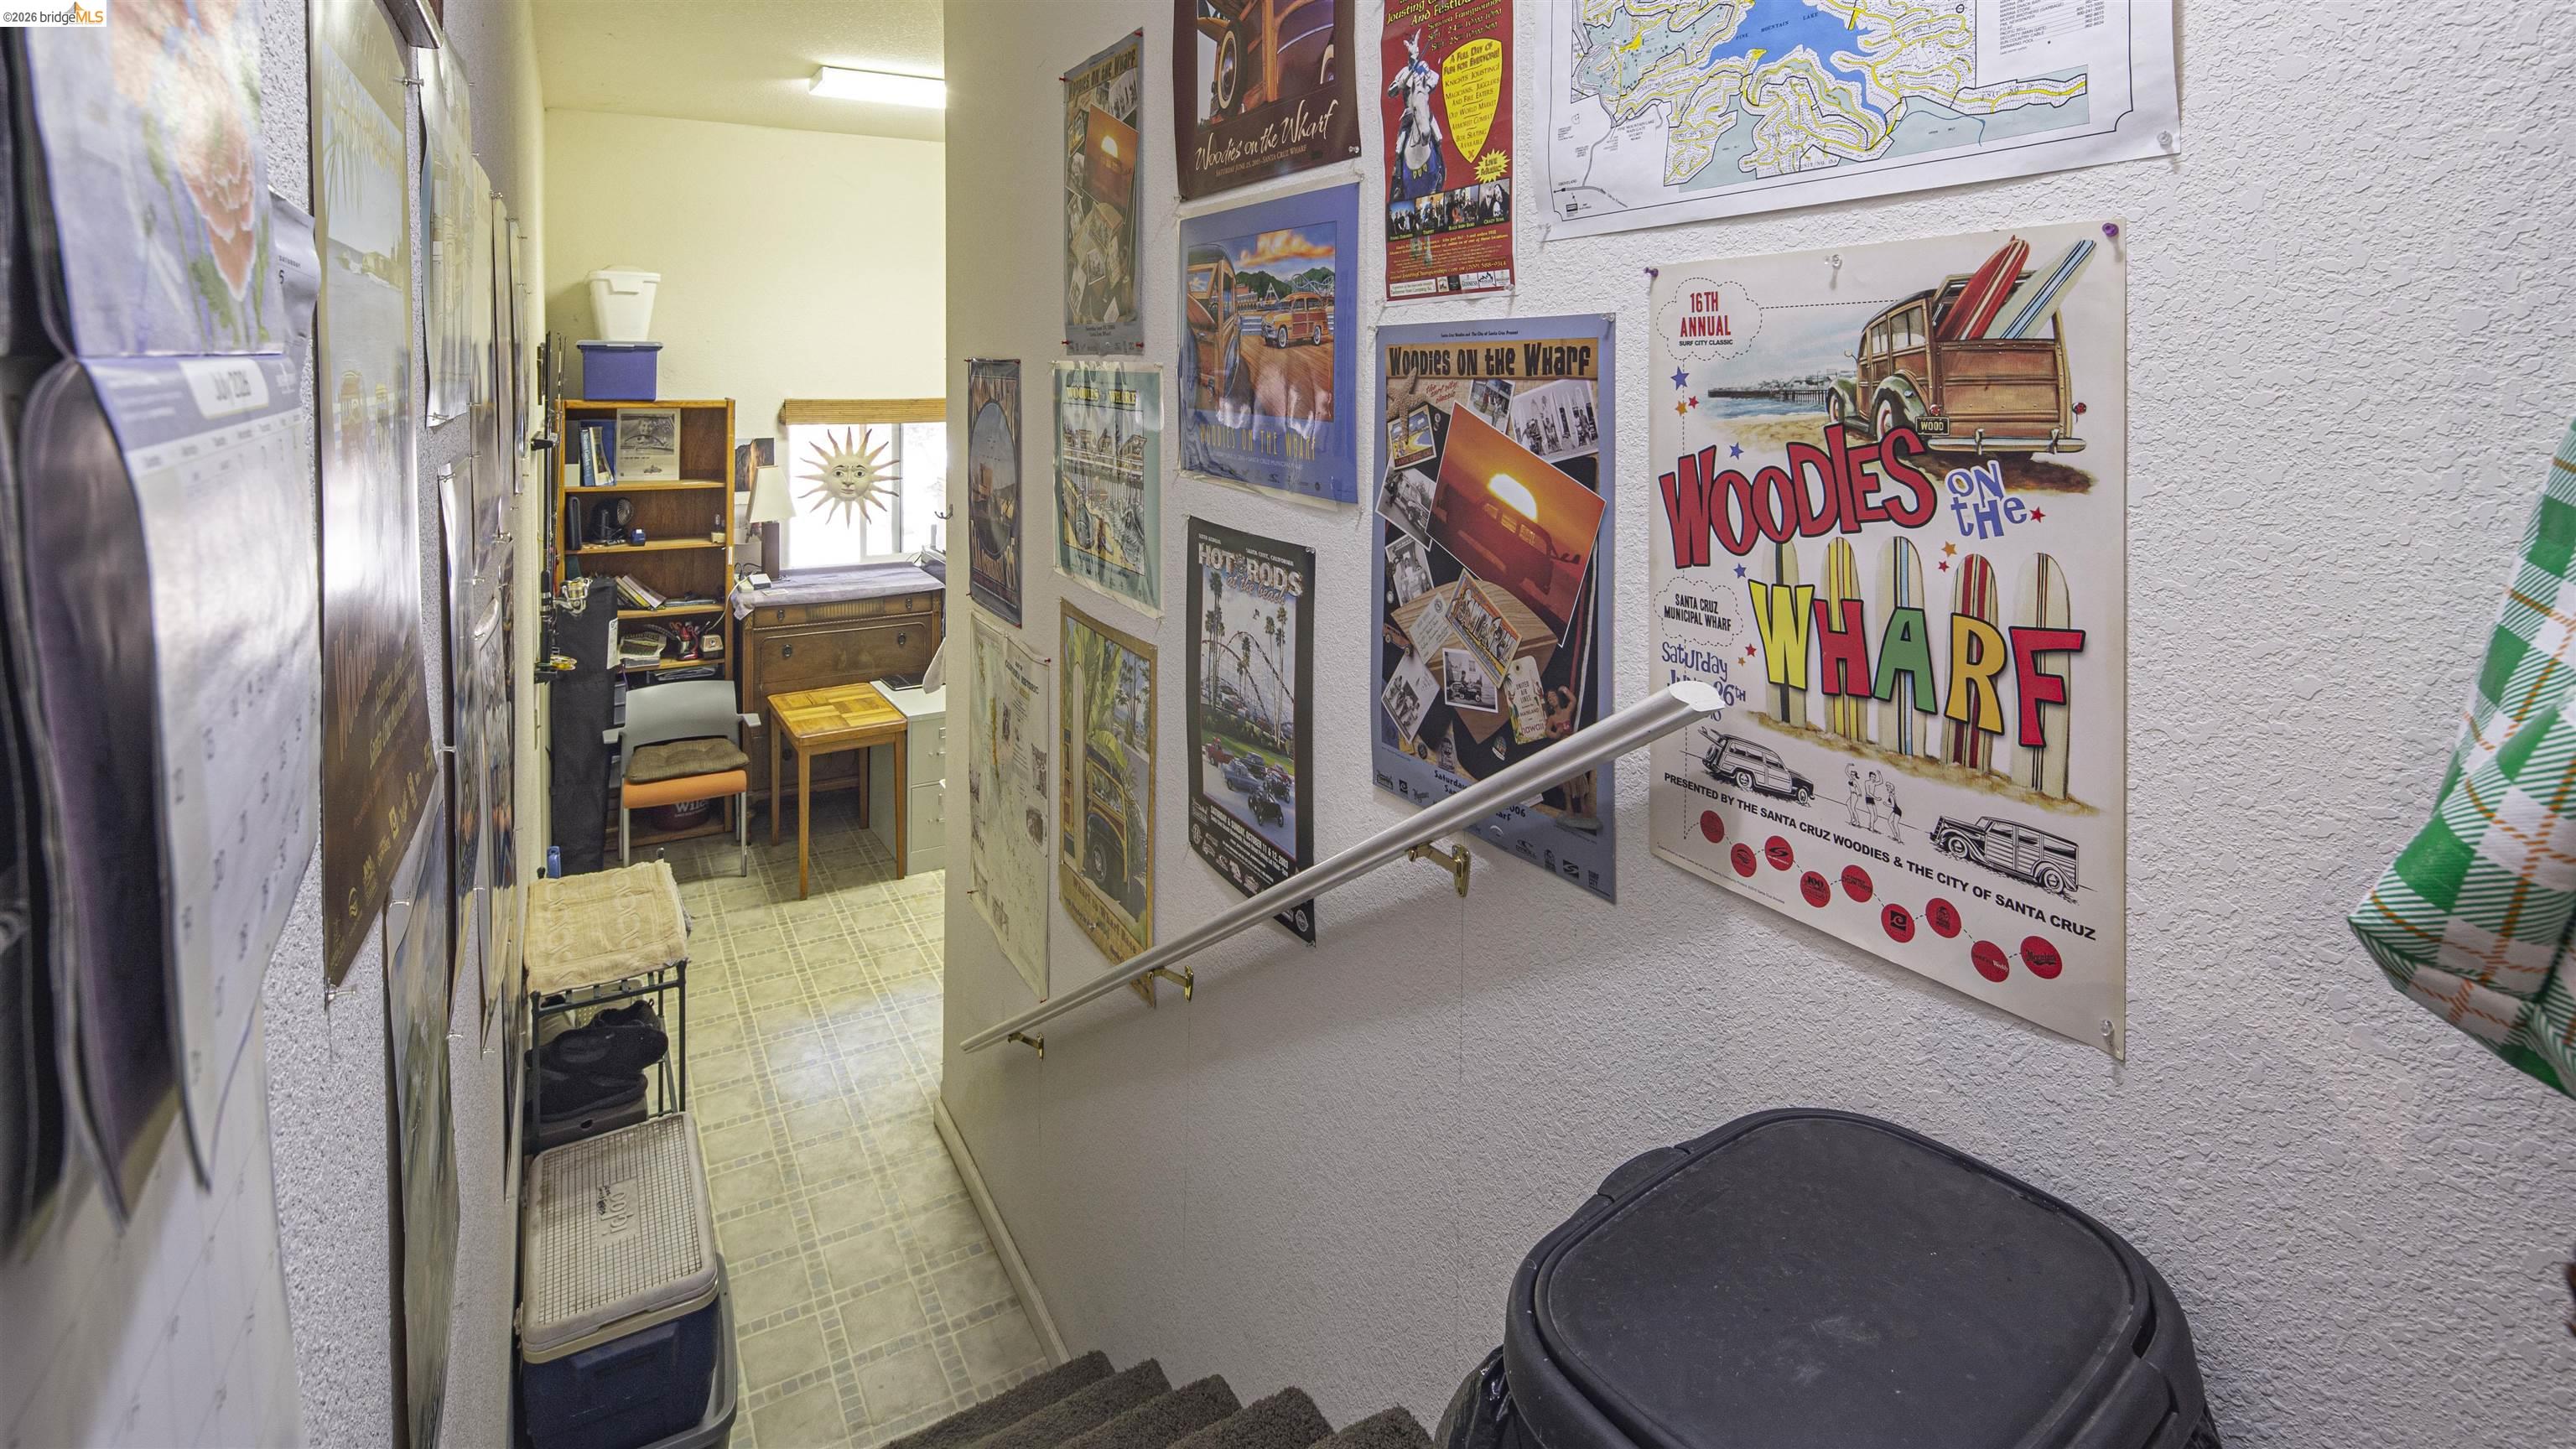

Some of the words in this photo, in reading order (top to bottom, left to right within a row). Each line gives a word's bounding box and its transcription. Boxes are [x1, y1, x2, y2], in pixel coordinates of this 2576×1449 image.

[1411, 9, 1431, 25] And
[1803, 13, 1819, 21] LAKE
[1195, 132, 1243, 170] Woodies
[1244, 139, 1258, 155] on
[1260, 123, 1279, 154] the
[1281, 99, 1338, 143] Wharf
[1690, 291, 1718, 313] 16TH
[1680, 315, 1731, 337] ANNUAL
[1921, 421, 1944, 431] WOOD
[1200, 424, 1235, 449] WOODIES
[1241, 428, 1253, 452] ON
[1260, 430, 1277, 455] THE
[1285, 432, 1316, 460] WHARF
[1659, 423, 1938, 569] WOODIES
[1947, 464, 2004, 508] ON
[1198, 543, 1235, 573] HOT
[1247, 557, 1303, 597] RODS
[1227, 576, 1238, 588] at
[1241, 579, 1254, 595] the
[1259, 581, 1285, 605] beach
[1664, 605, 1703, 626] MUNICIPAL
[1705, 614, 1731, 631] WHARF
[1675, 594, 1698, 610] SANTA
[1700, 598, 1718, 615] CRUZ
[1662, 641, 1727, 682] Saturday
[1748, 579, 2086, 747] WHARF
[1516, 681, 1530, 690] UNITED
[1521, 719, 1544, 735] hawaii
[1664, 772, 1718, 801] PRESENTED
[1721, 795, 1734, 806] BY
[1737, 799, 1758, 815] THE
[1761, 807, 1797, 828] SANTA
[1800, 822, 1831, 840] CRUZ
[1833, 834, 1890, 863] WOODIES
[1893, 858, 1903, 868] &
[1907, 860, 1934, 880] THE
[1937, 873, 1970, 892] CITY
[1972, 886, 1992, 901] OF
[1995, 894, 2046, 922] SANTA
[2050, 916, 2096, 940] CRUZ
